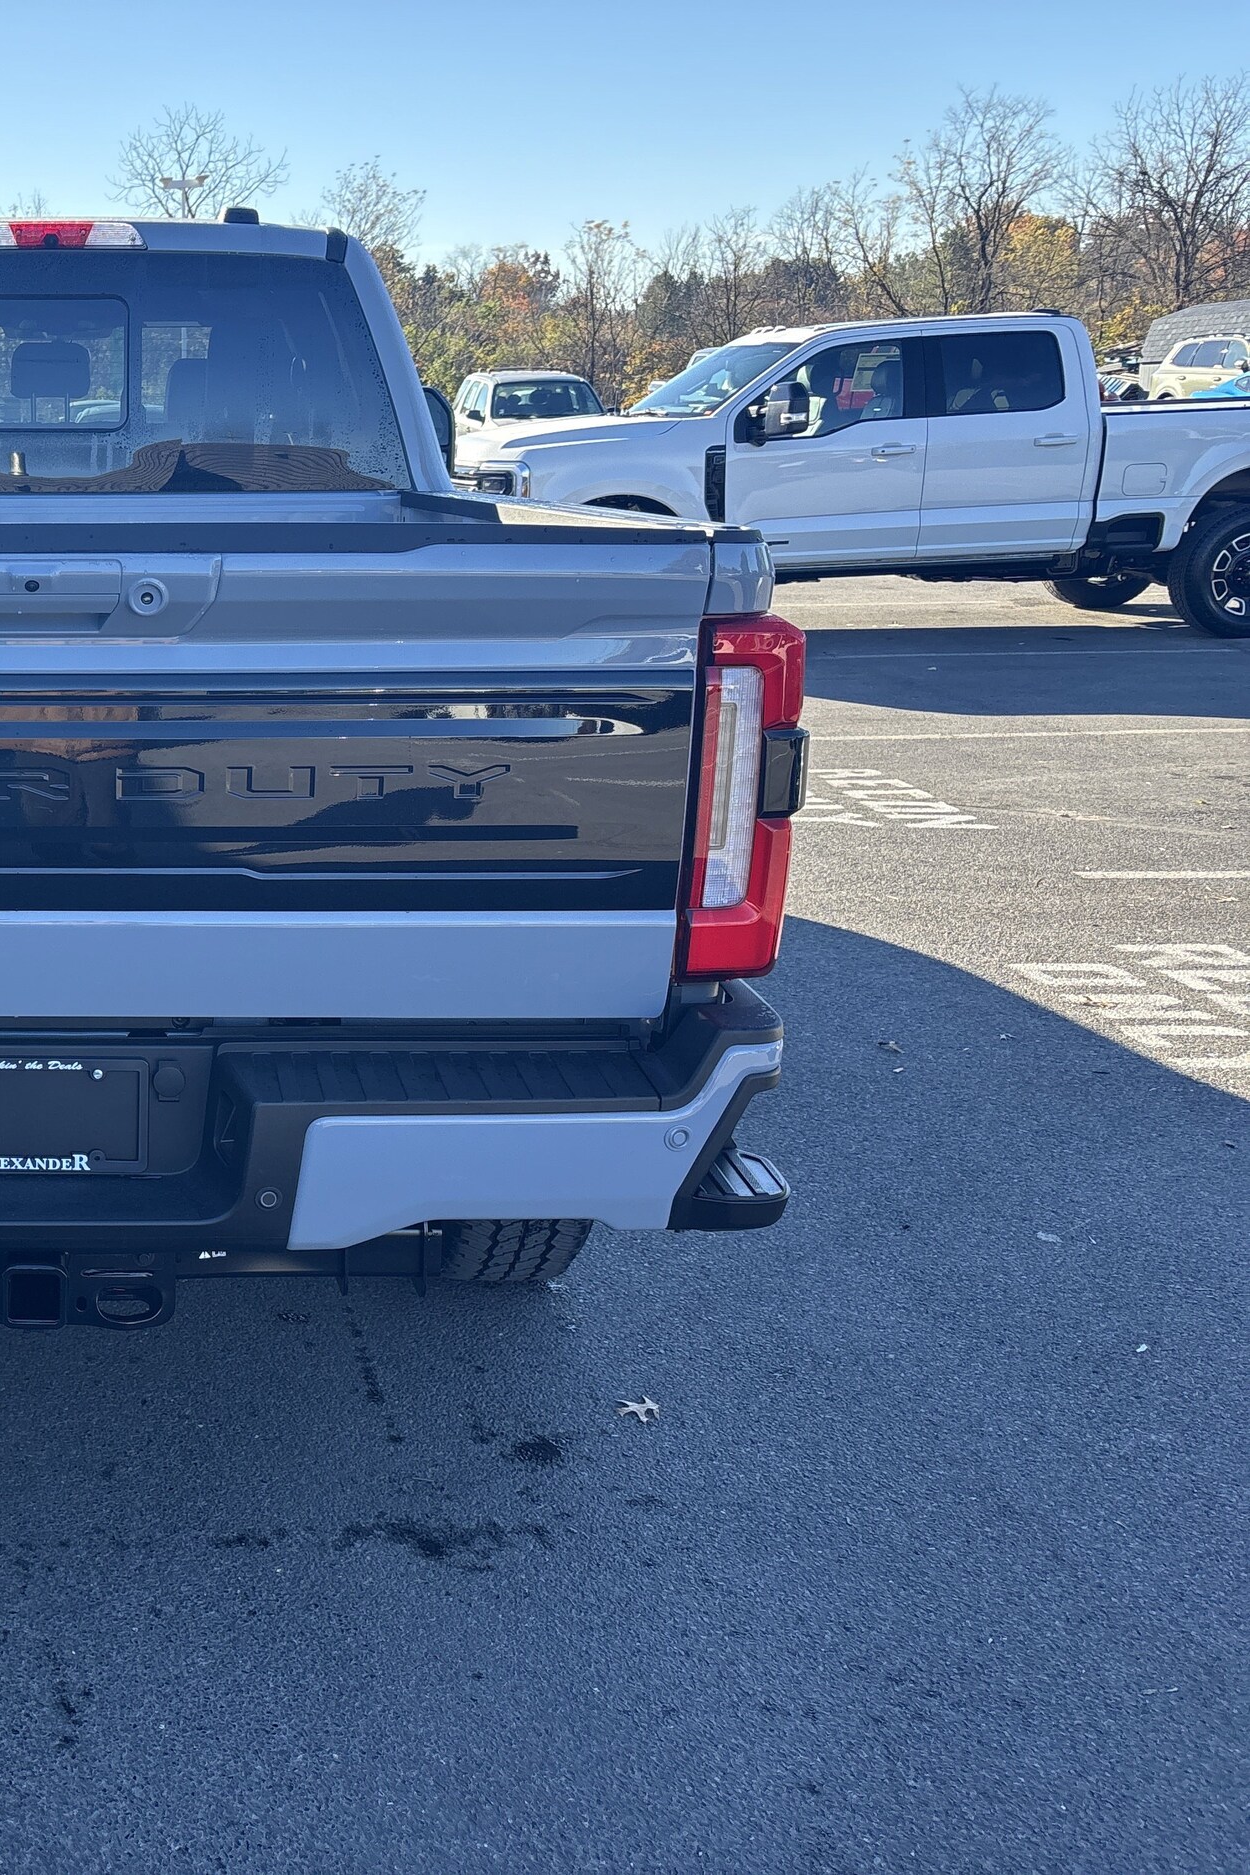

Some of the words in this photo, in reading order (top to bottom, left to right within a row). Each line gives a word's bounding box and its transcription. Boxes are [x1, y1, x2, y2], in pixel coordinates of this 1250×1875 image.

[116, 764, 512, 801] DUTY
[24, 1060, 43, 1070] the
[47, 1060, 84, 1071] Deals
